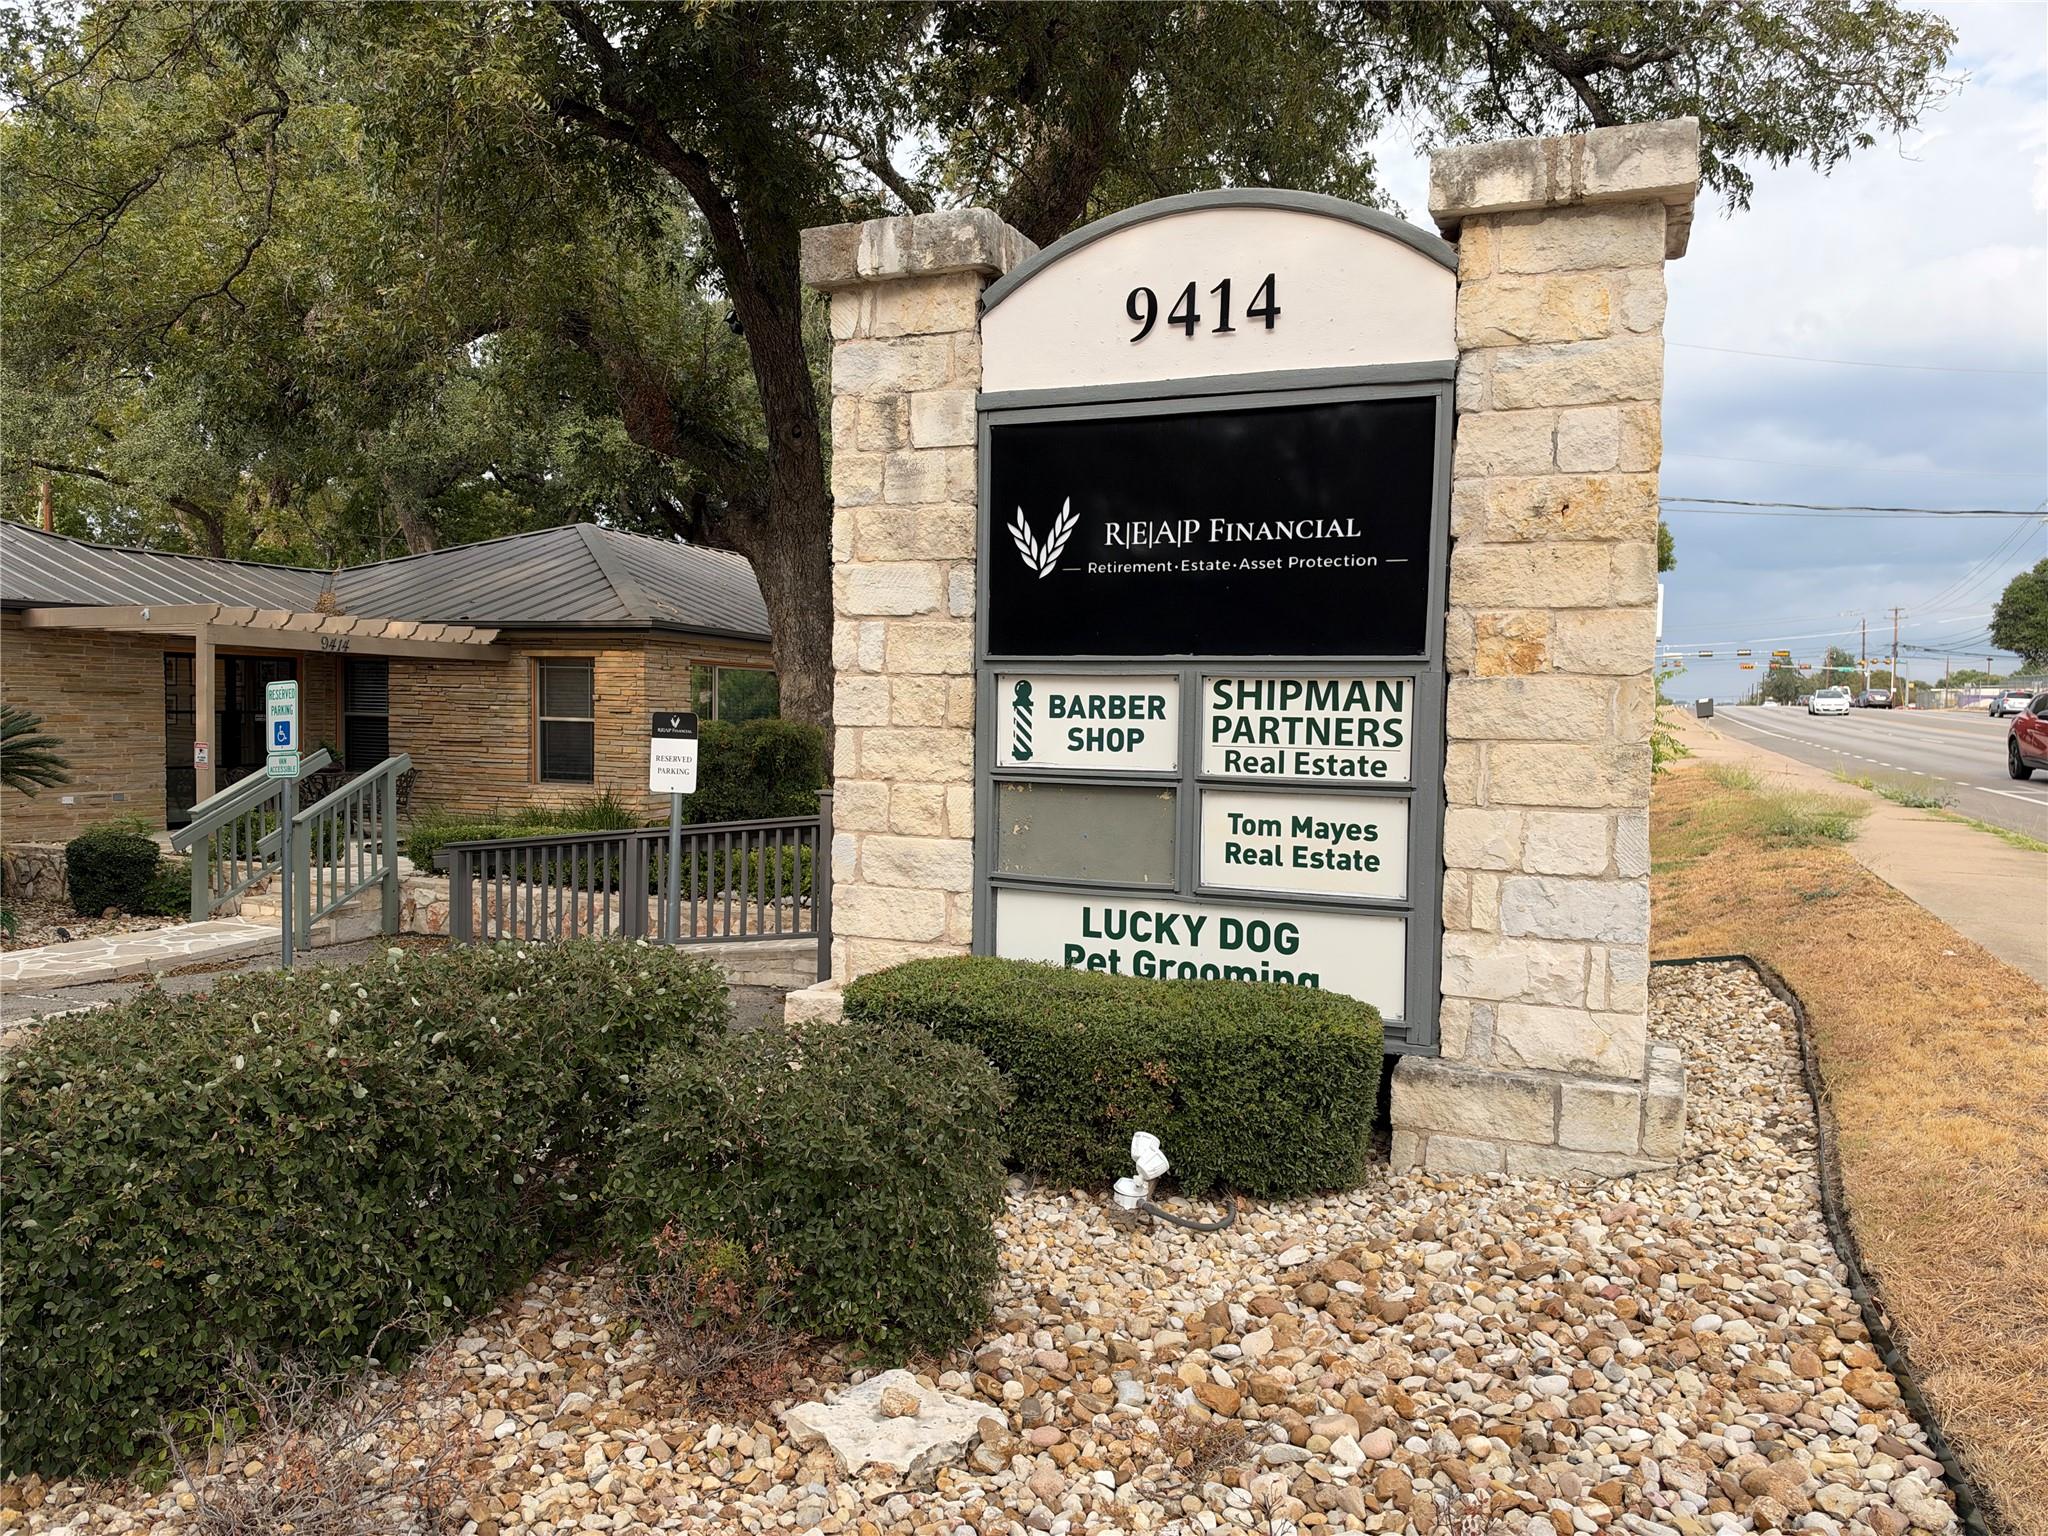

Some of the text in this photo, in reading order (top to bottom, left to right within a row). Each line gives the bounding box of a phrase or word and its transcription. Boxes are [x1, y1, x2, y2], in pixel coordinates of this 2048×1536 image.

[1126, 272, 1281, 343] 9414
[1288, 554, 1378, 568] Protection
[320, 636, 350, 651] 9414
[268, 688, 295, 701] RESERVED
[1049, 695, 1167, 720] BARBER
[1212, 679, 1404, 712] SHIPMAN
[271, 704, 294, 716] PARKING
[1067, 727, 1145, 753] SHOP
[1212, 716, 1404, 748] PARTNERS
[655, 755, 692, 763] RESERVED
[657, 767, 690, 775] PARKING
[1224, 750, 1388, 778] Real Estate
[1227, 813, 1379, 845] Tom Mayes
[1224, 842, 1381, 873] Real Estate
[1082, 906, 1300, 955] LUCKY DOG
[1064, 943, 1121, 976] Pet
